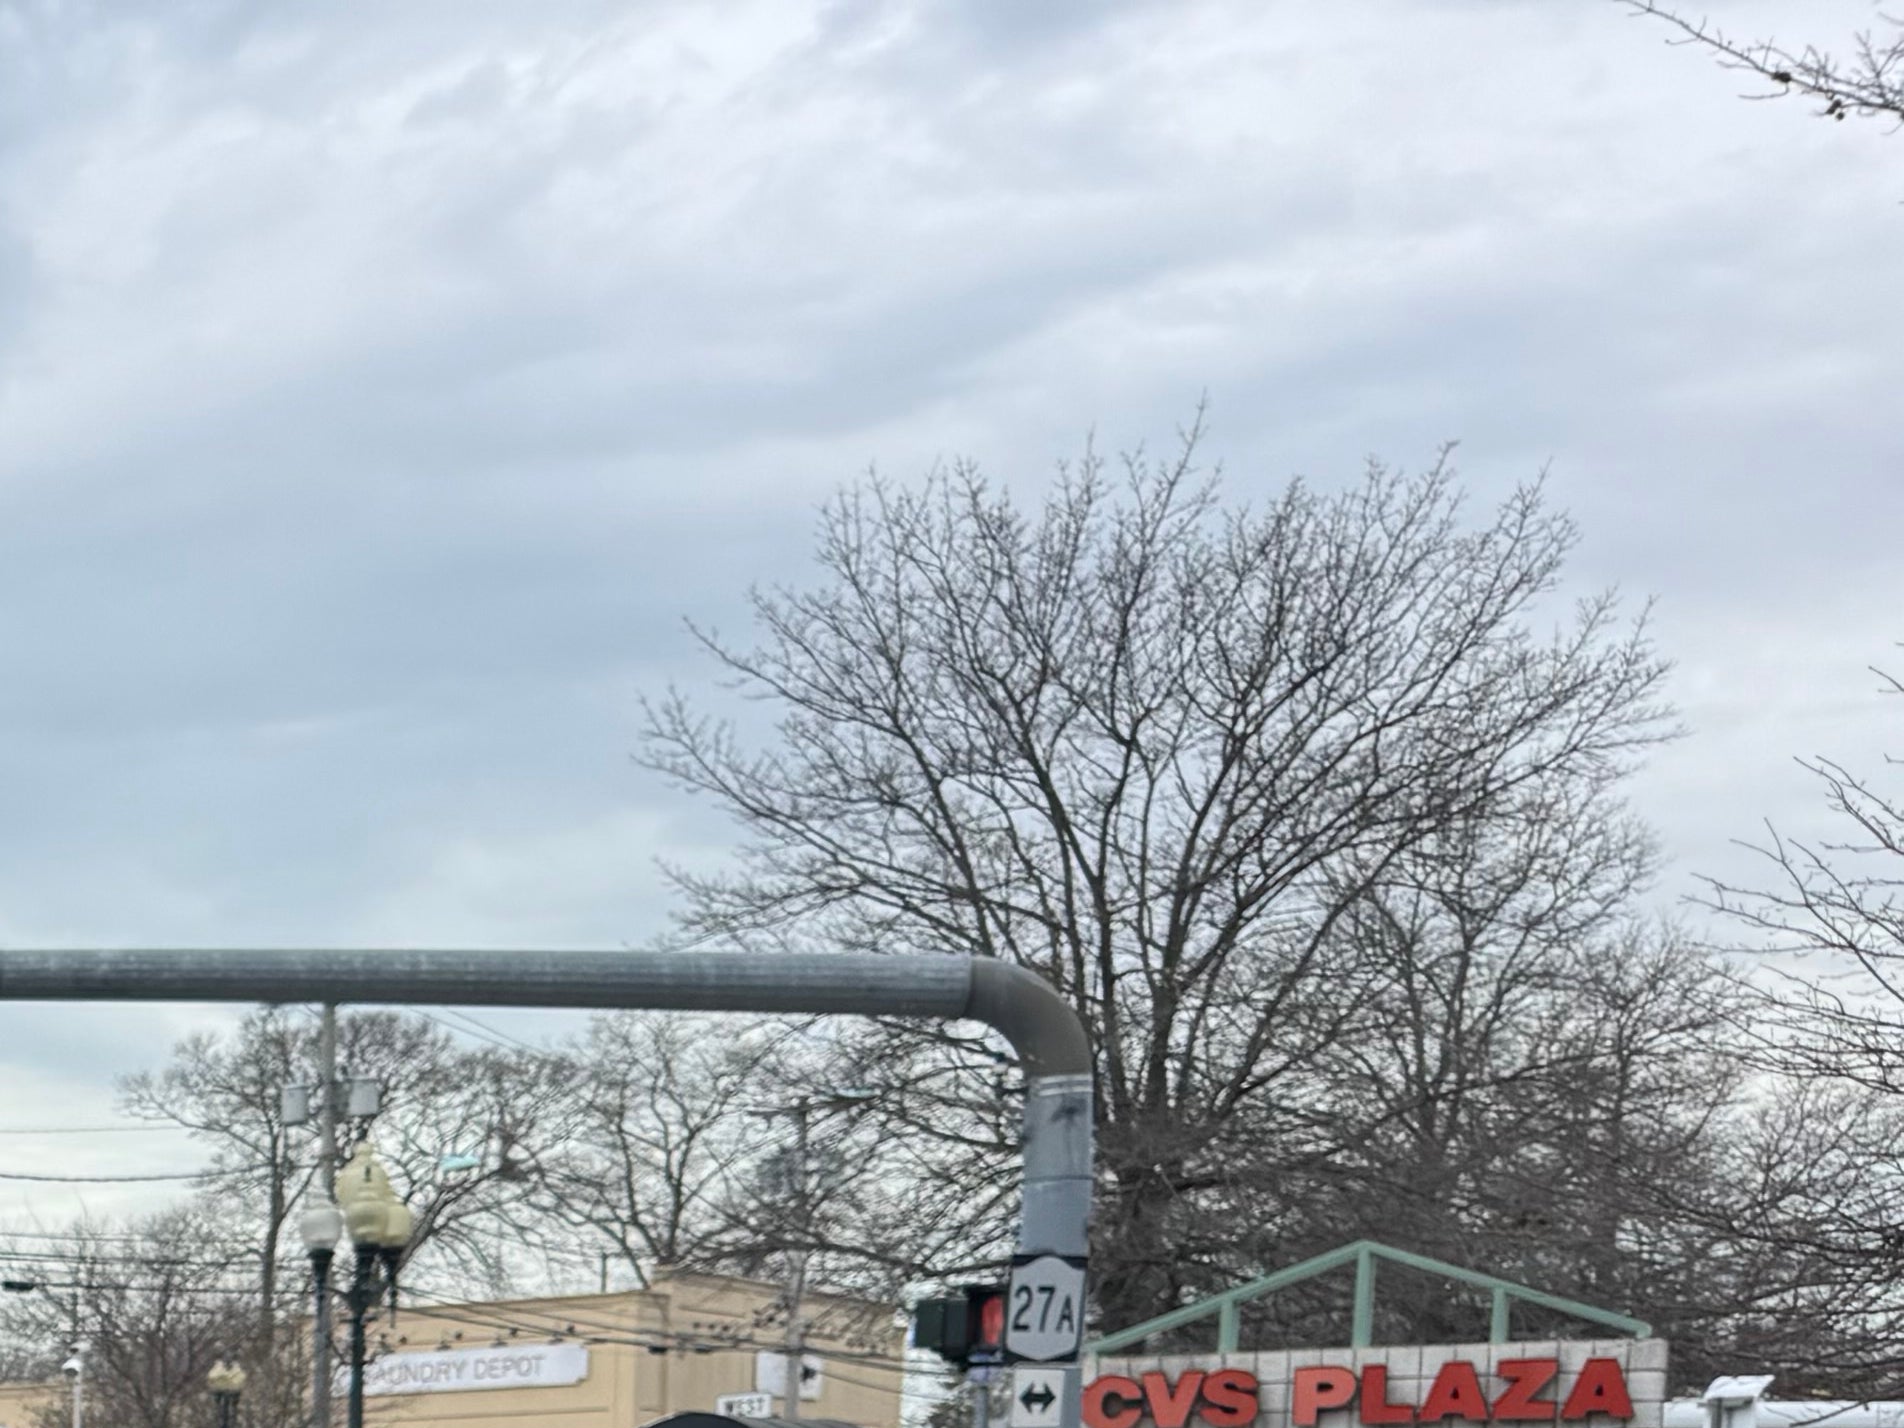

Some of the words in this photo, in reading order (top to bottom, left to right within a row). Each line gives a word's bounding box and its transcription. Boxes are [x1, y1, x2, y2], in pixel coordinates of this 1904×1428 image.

[1012, 1284, 1075, 1334] 27A
[473, 1356, 545, 1380] DEPOT
[1293, 1357, 1633, 1427] PLAZA
